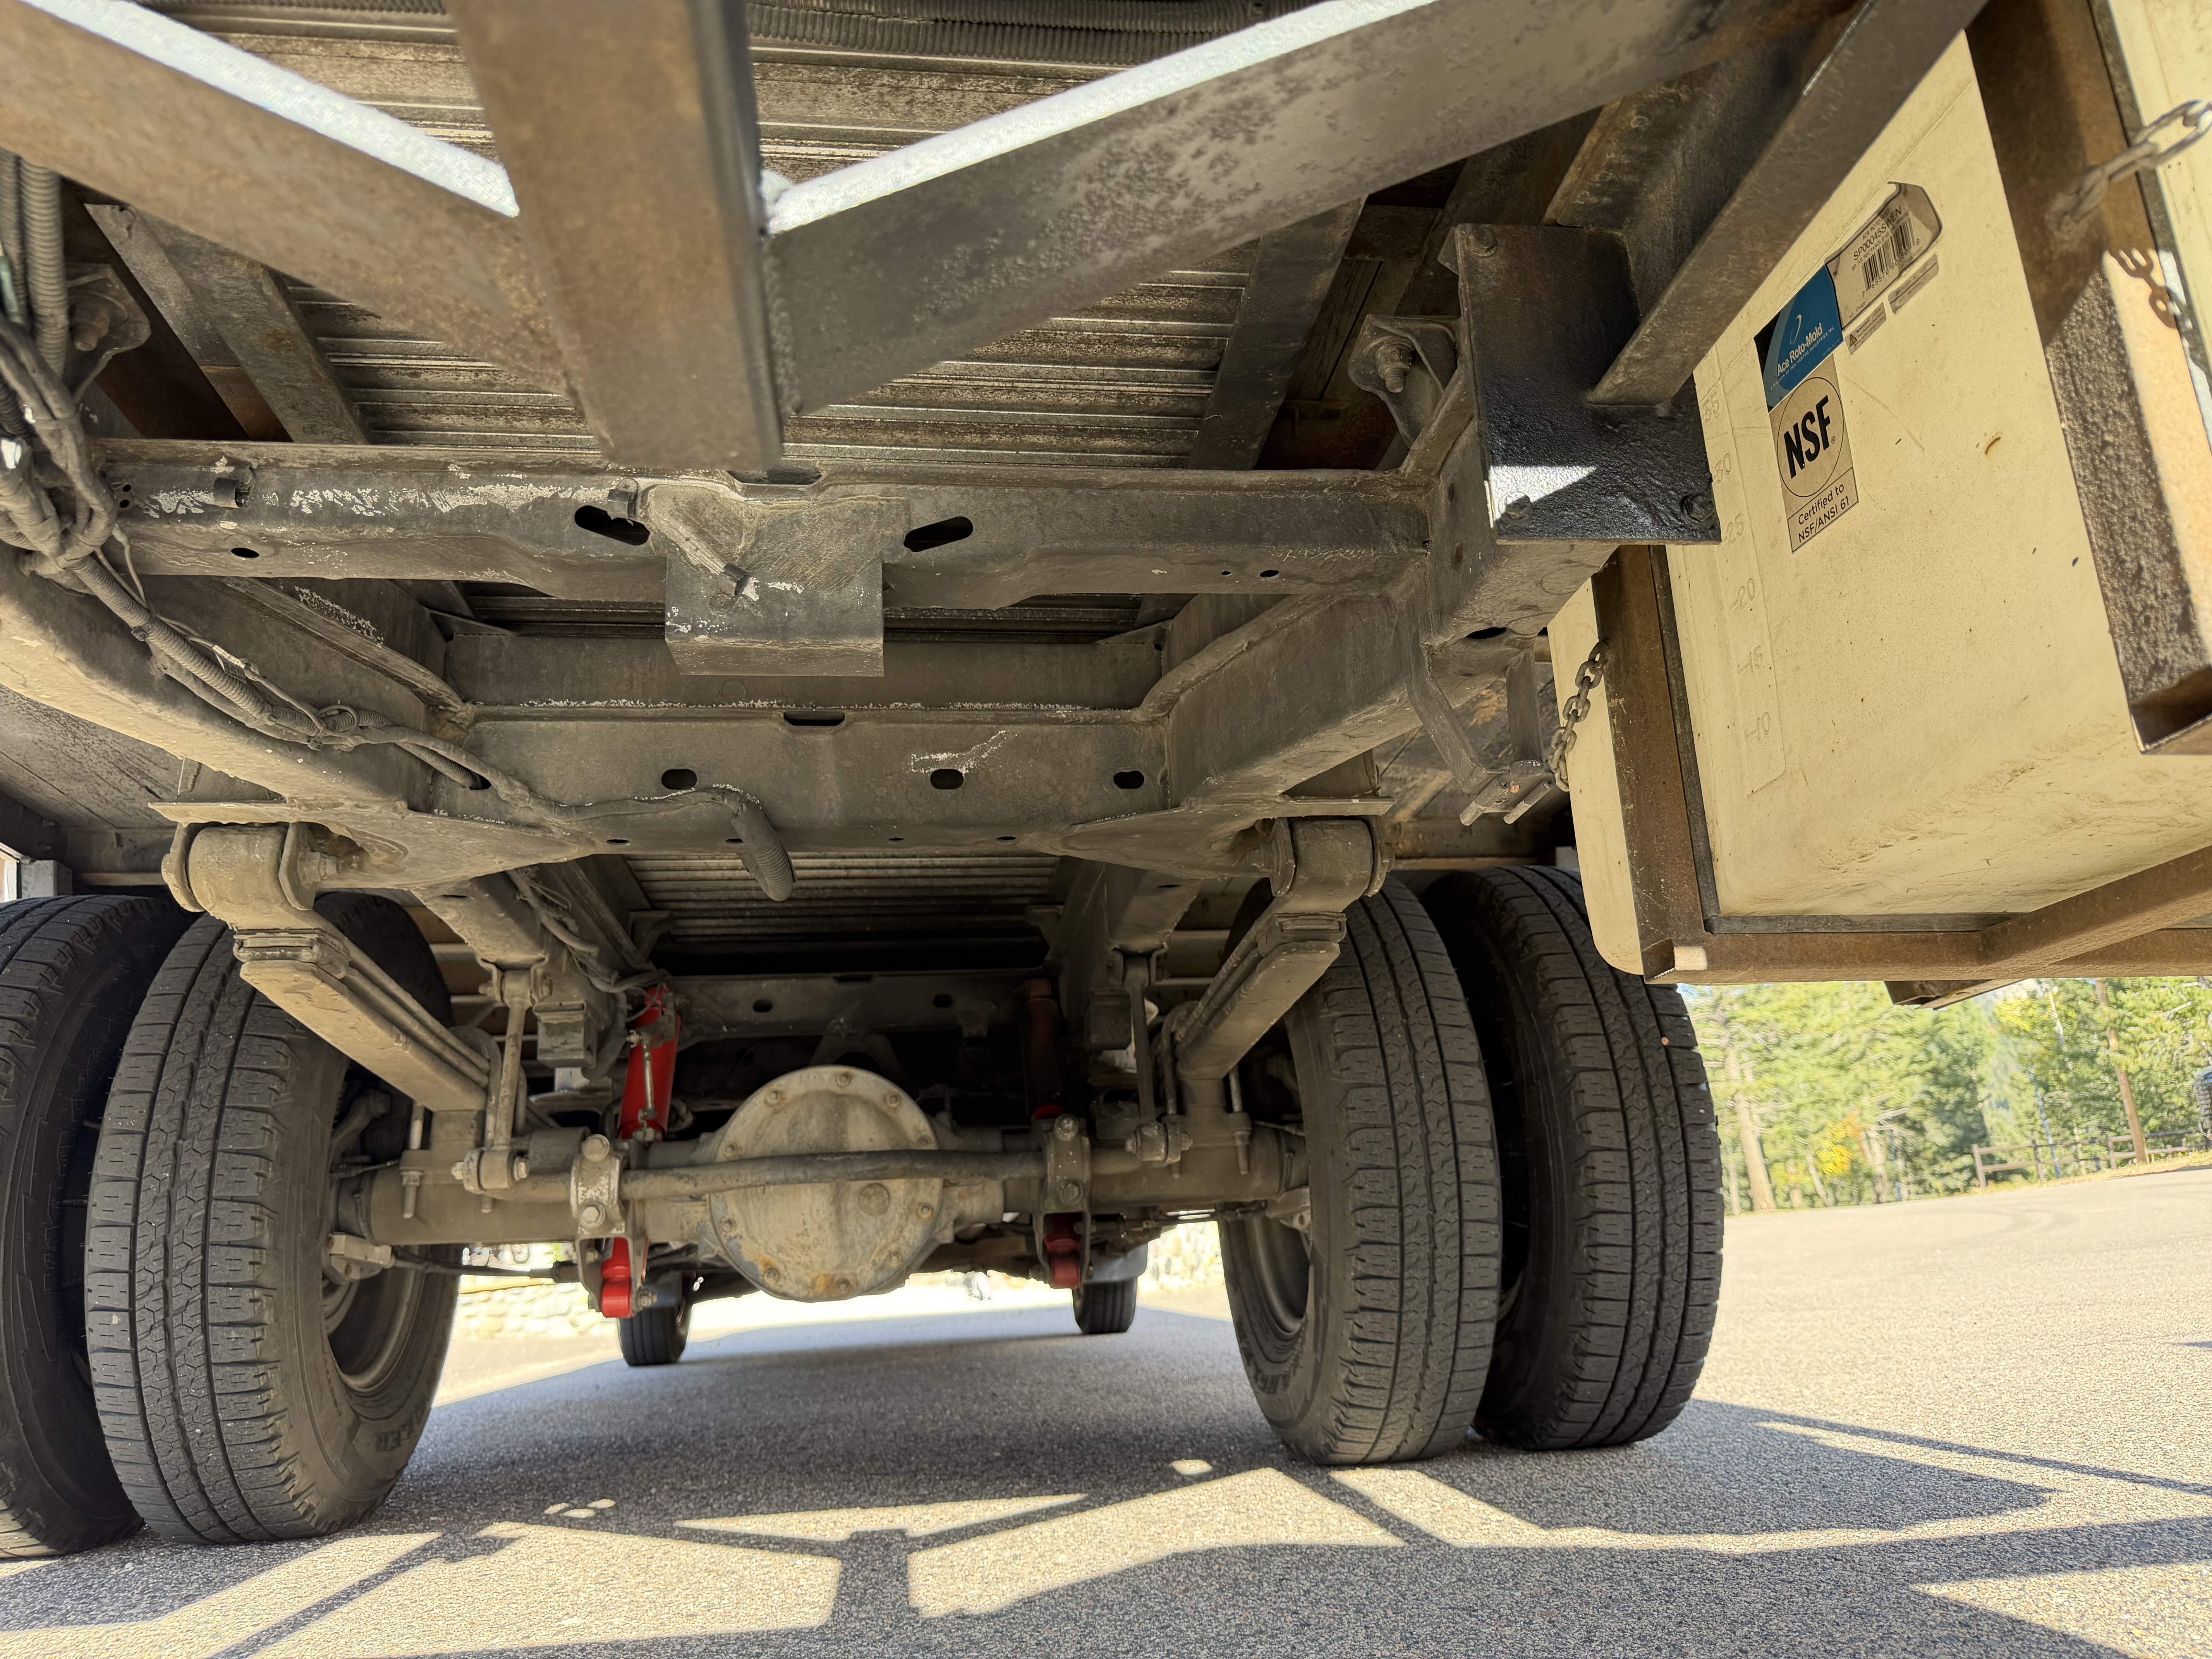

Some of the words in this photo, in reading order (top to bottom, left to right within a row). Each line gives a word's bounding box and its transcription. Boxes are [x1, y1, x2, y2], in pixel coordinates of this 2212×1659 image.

[1853, 206, 1902, 261] SP00045SWEN
[1863, 236, 1884, 260] RECTANGLE
[1871, 268, 1889, 289] 68570
[1778, 359, 1790, 376] Ace
[1790, 322, 1823, 363] Roto-Mold
[1783, 394, 1831, 479] NSF
[1798, 489, 1833, 525] Certified
[1835, 484, 1844, 496] to
[1798, 504, 1838, 543] NSF/ANSI
[1840, 495, 1849, 510] 61
